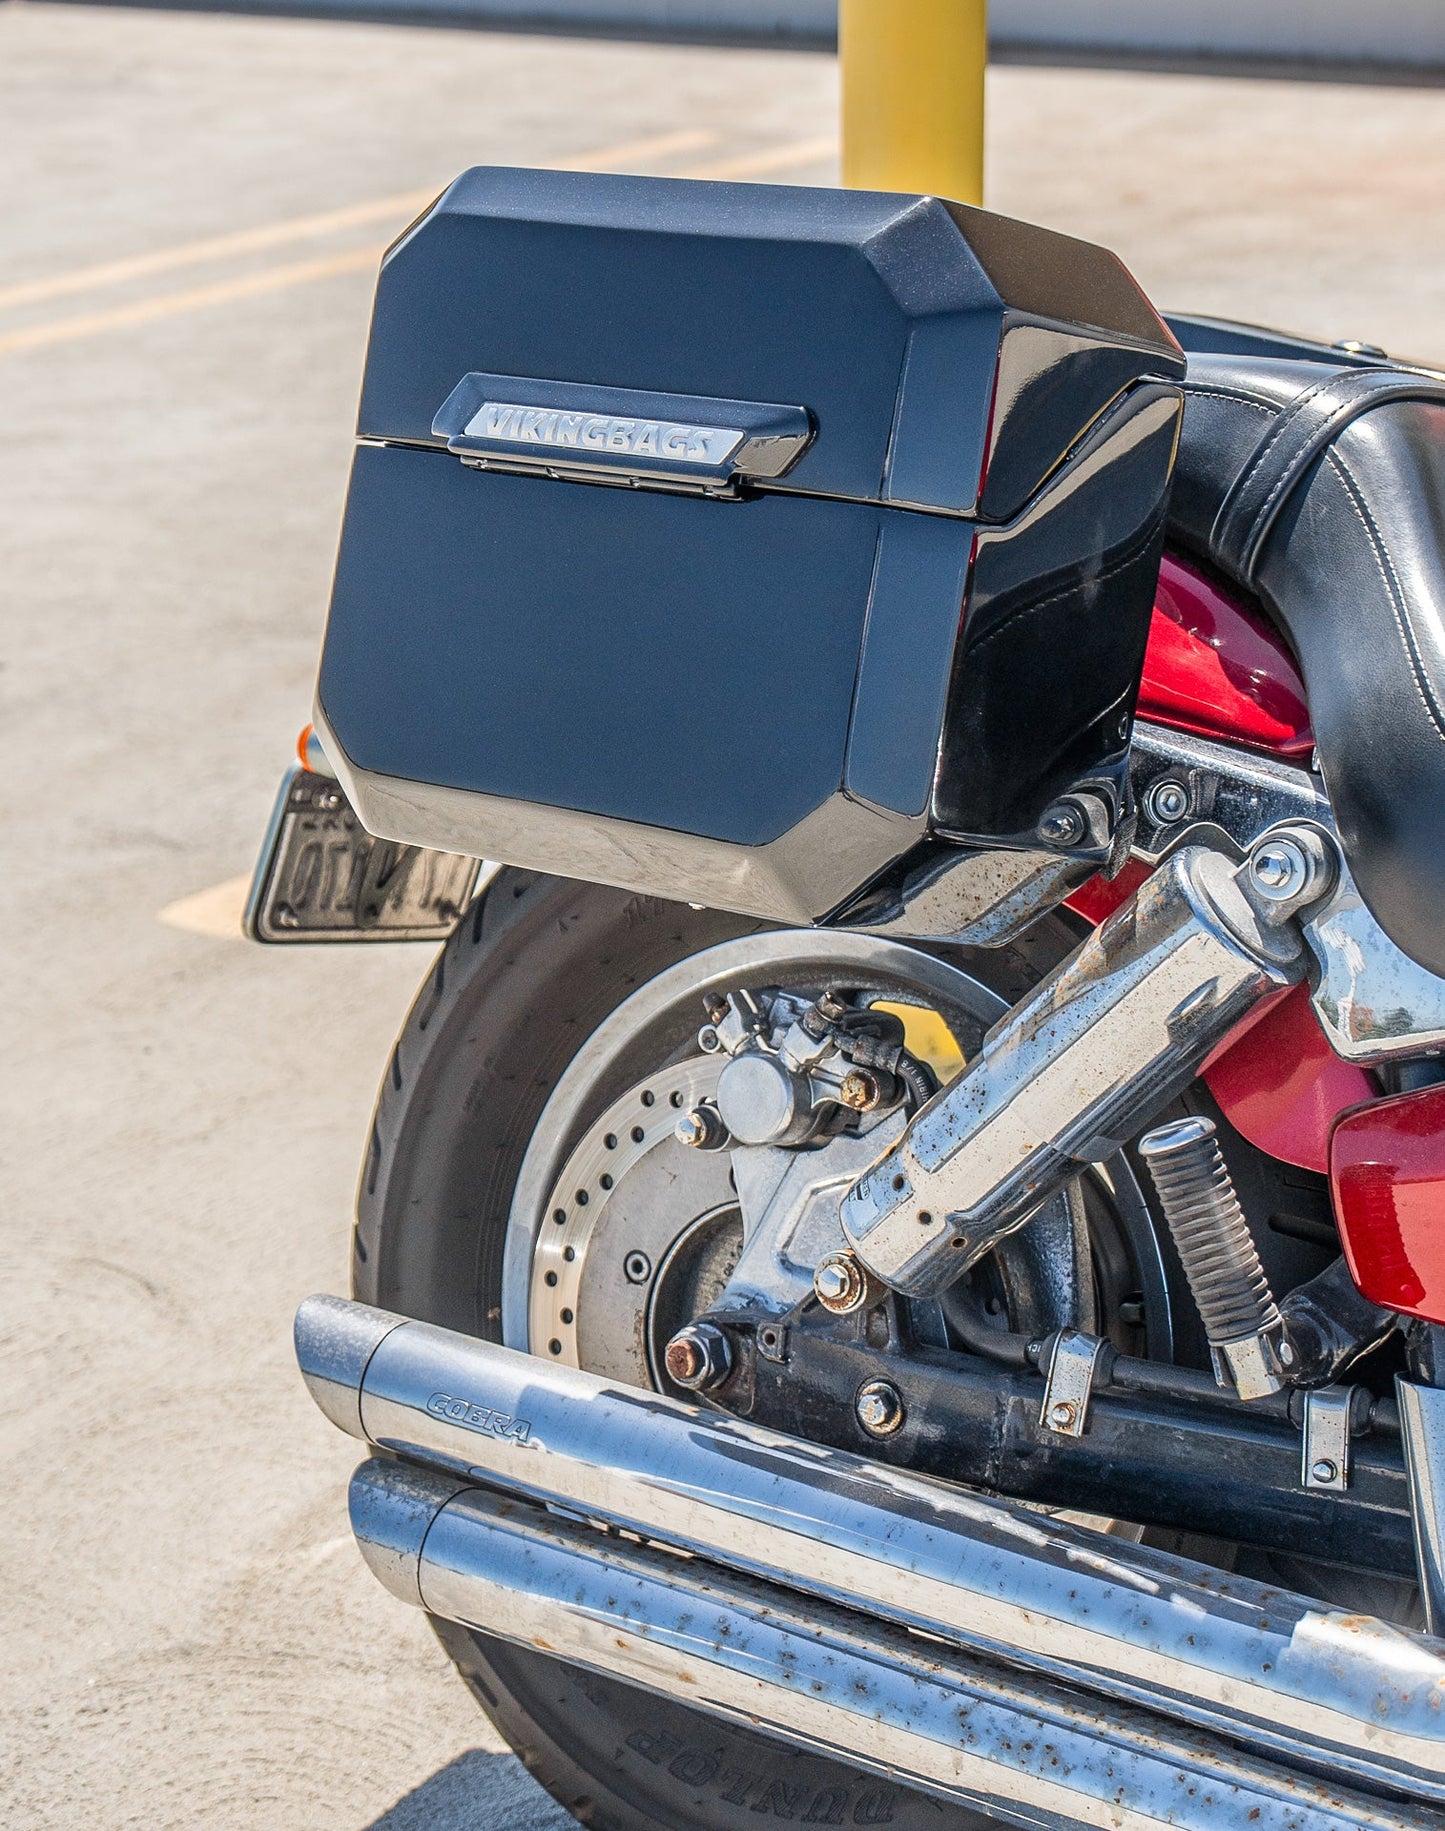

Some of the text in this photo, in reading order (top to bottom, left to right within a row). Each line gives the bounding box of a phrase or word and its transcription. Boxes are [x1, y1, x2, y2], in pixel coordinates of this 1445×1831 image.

[485, 406, 713, 459] VIKINGBAGS
[426, 1392, 532, 1442] COBRA
[626, 1728, 897, 1825] DUNLOP
